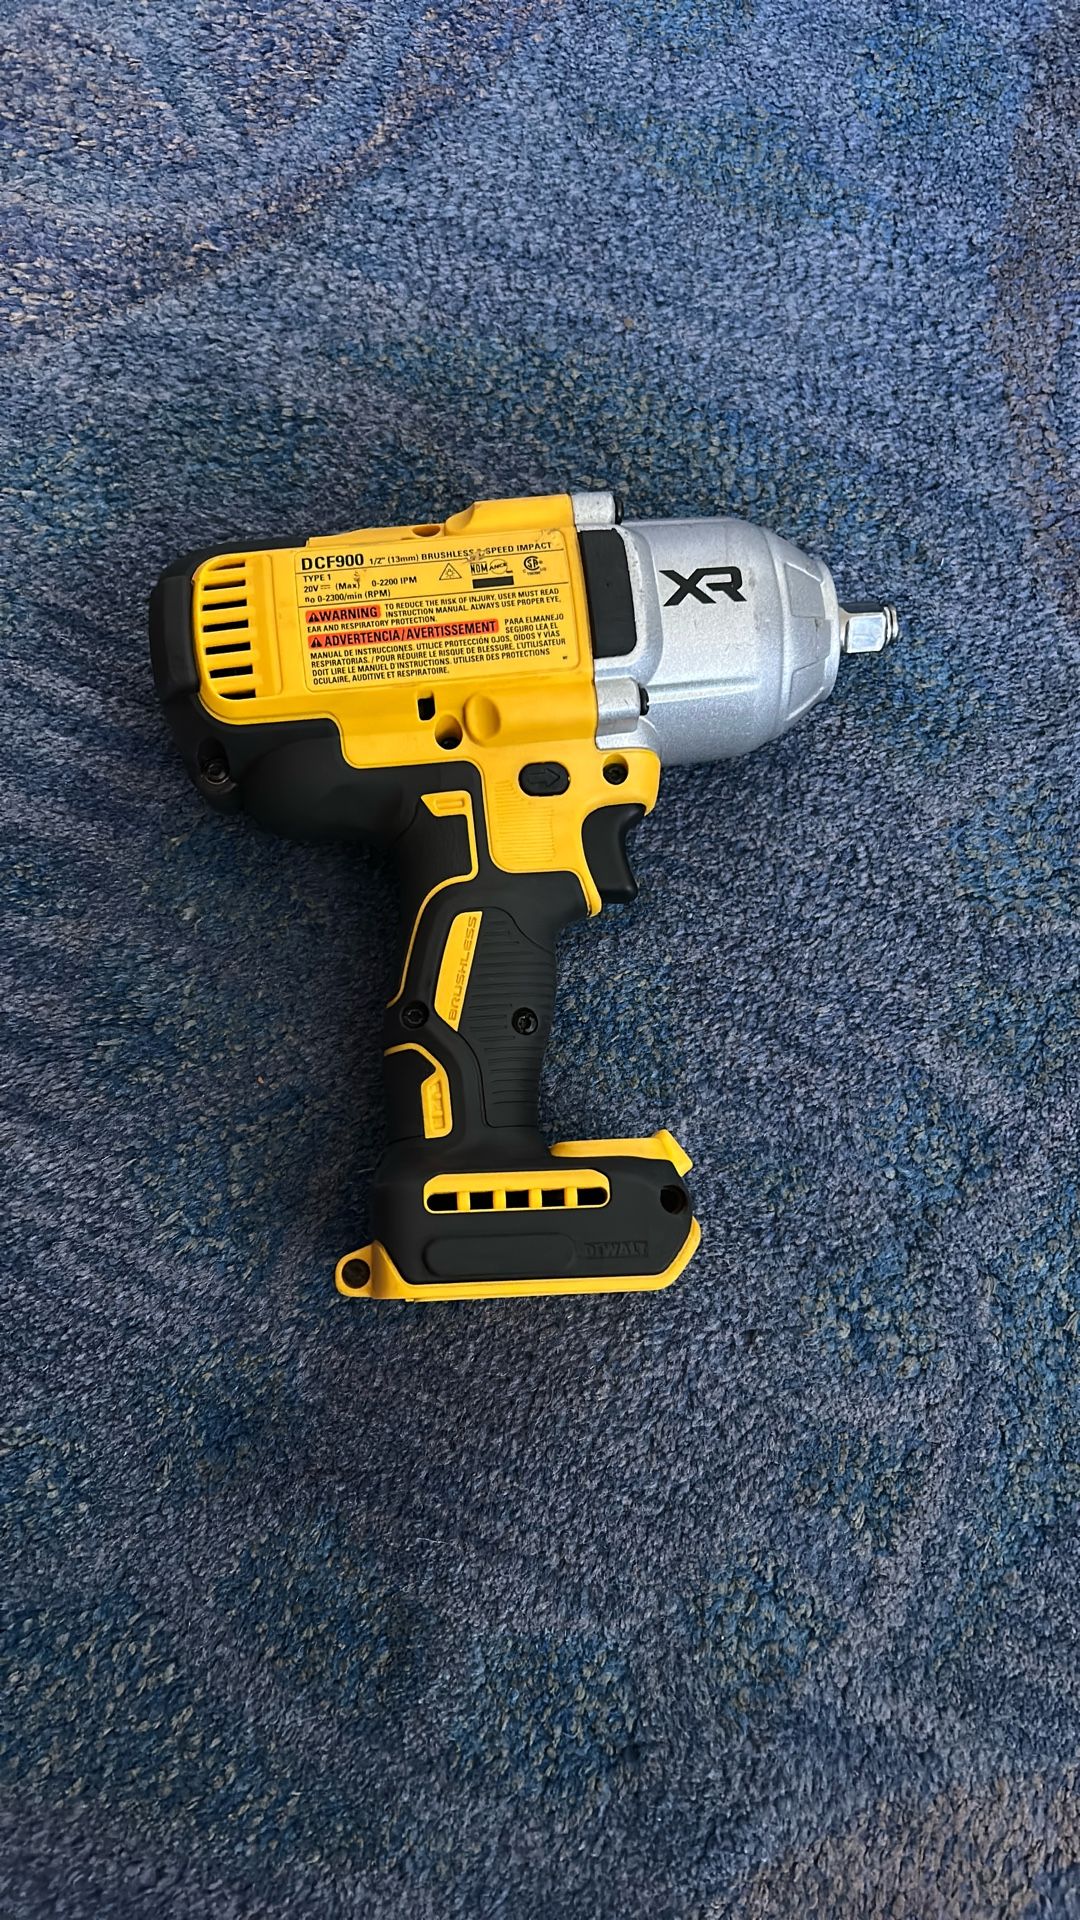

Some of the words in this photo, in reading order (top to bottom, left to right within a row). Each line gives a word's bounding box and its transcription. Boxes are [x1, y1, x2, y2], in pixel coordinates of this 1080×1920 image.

[301, 553, 364, 571] DCF900
[387, 554, 419, 564] (13mm)
[421, 549, 474, 560] BRUSHLESS
[516, 542, 552, 552] IMPACT
[470, 563, 488, 574] NOM
[303, 574, 325, 583] TYPE
[371, 578, 398, 587] 0-2200
[400, 576, 418, 584] IPM
[659, 566, 747, 606] XR
[303, 585, 319, 593] 20V
[335, 582, 360, 591] (Max)
[317, 592, 362, 603] 0-2300/min
[365, 589, 391, 600] (RPM)
[396, 601, 424, 609] REDUCE
[498, 592, 516, 600] USER
[518, 590, 539, 598] MUST
[540, 588, 559, 596] READ
[319, 606, 378, 622] WARNING
[386, 608, 434, 618] INSTRUCTION
[470, 601, 500, 611] ALWAYS
[501, 599, 515, 607] USE
[517, 598, 544, 606] PROPER
[341, 620, 389, 630] RESPIRATORY
[391, 616, 438, 626] PROTECTION.
[504, 617, 524, 625] PARA
[505, 624, 534, 634] SEGURO
[535, 623, 548, 631] LEA
[310, 651, 342, 660] MANUAL
[416, 641, 443, 651] UTILICE
[444, 636, 489, 648] PROTECCIÓN
[376, 654, 396, 662] POUR
[438, 647, 465, 656] RISQUE
[466, 646, 475, 654] DE
[312, 669, 329, 677] DOIT
[331, 667, 346, 675] LIRE
[357, 664, 389, 672] MANUEL
[453, 655, 484, 665] UTILISER
[486, 653, 500, 661] DES
[501, 648, 550, 659] PROTECTIONS
[352, 671, 385, 682] AUDITIVE
[397, 666, 450, 677] RESPIRATOIRE.
[448, 916, 478, 1022] BRUSHLESS
